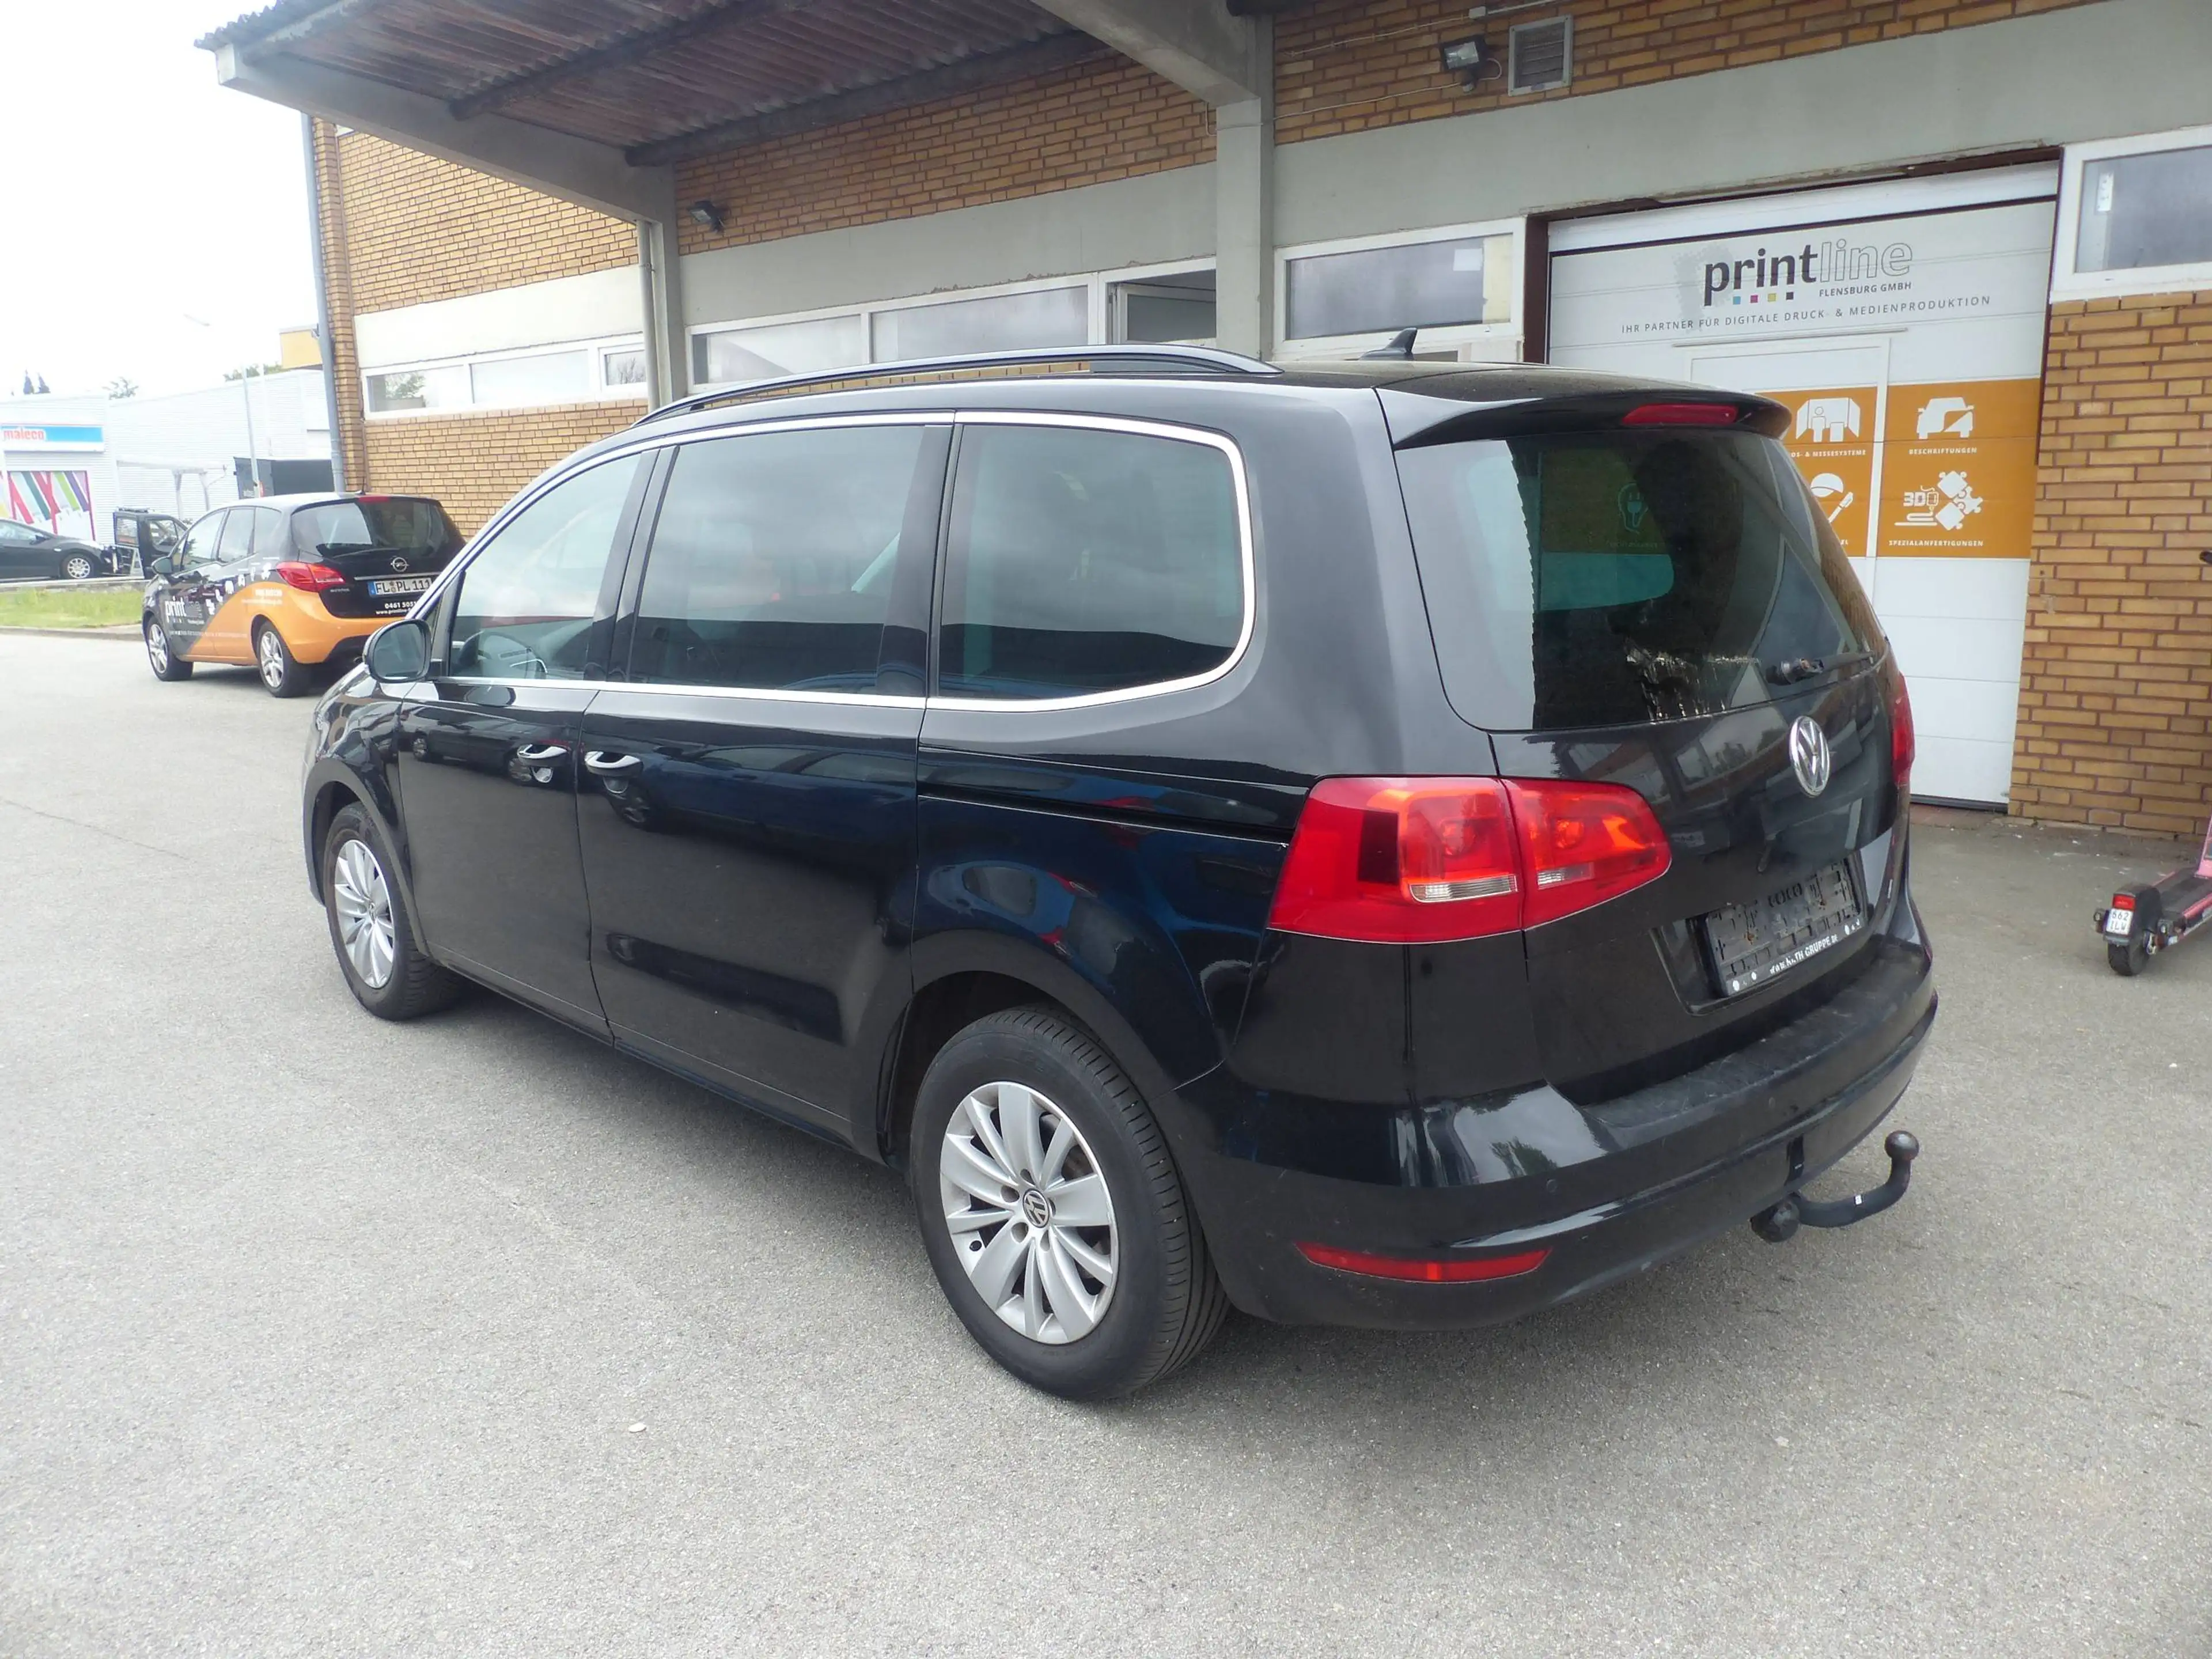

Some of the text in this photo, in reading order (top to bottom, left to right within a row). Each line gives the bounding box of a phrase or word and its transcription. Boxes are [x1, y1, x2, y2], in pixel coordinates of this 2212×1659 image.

[1703, 238, 1913, 306] printline
[1819, 282, 1912, 297] FLENSBURG GMBH
[1622, 324, 1640, 334] IHR
[1645, 319, 1694, 332] PARTNER
[1699, 317, 1720, 328] FÜR
[1725, 313, 1779, 326] DIGITALE
[1835, 308, 1843, 317] &
[1849, 295, 1991, 317] MEDIENPRODUKTION
[1903, 491, 1926, 507] 3D
[376, 582, 390, 593] FL
[397, 580, 410, 592] PL
